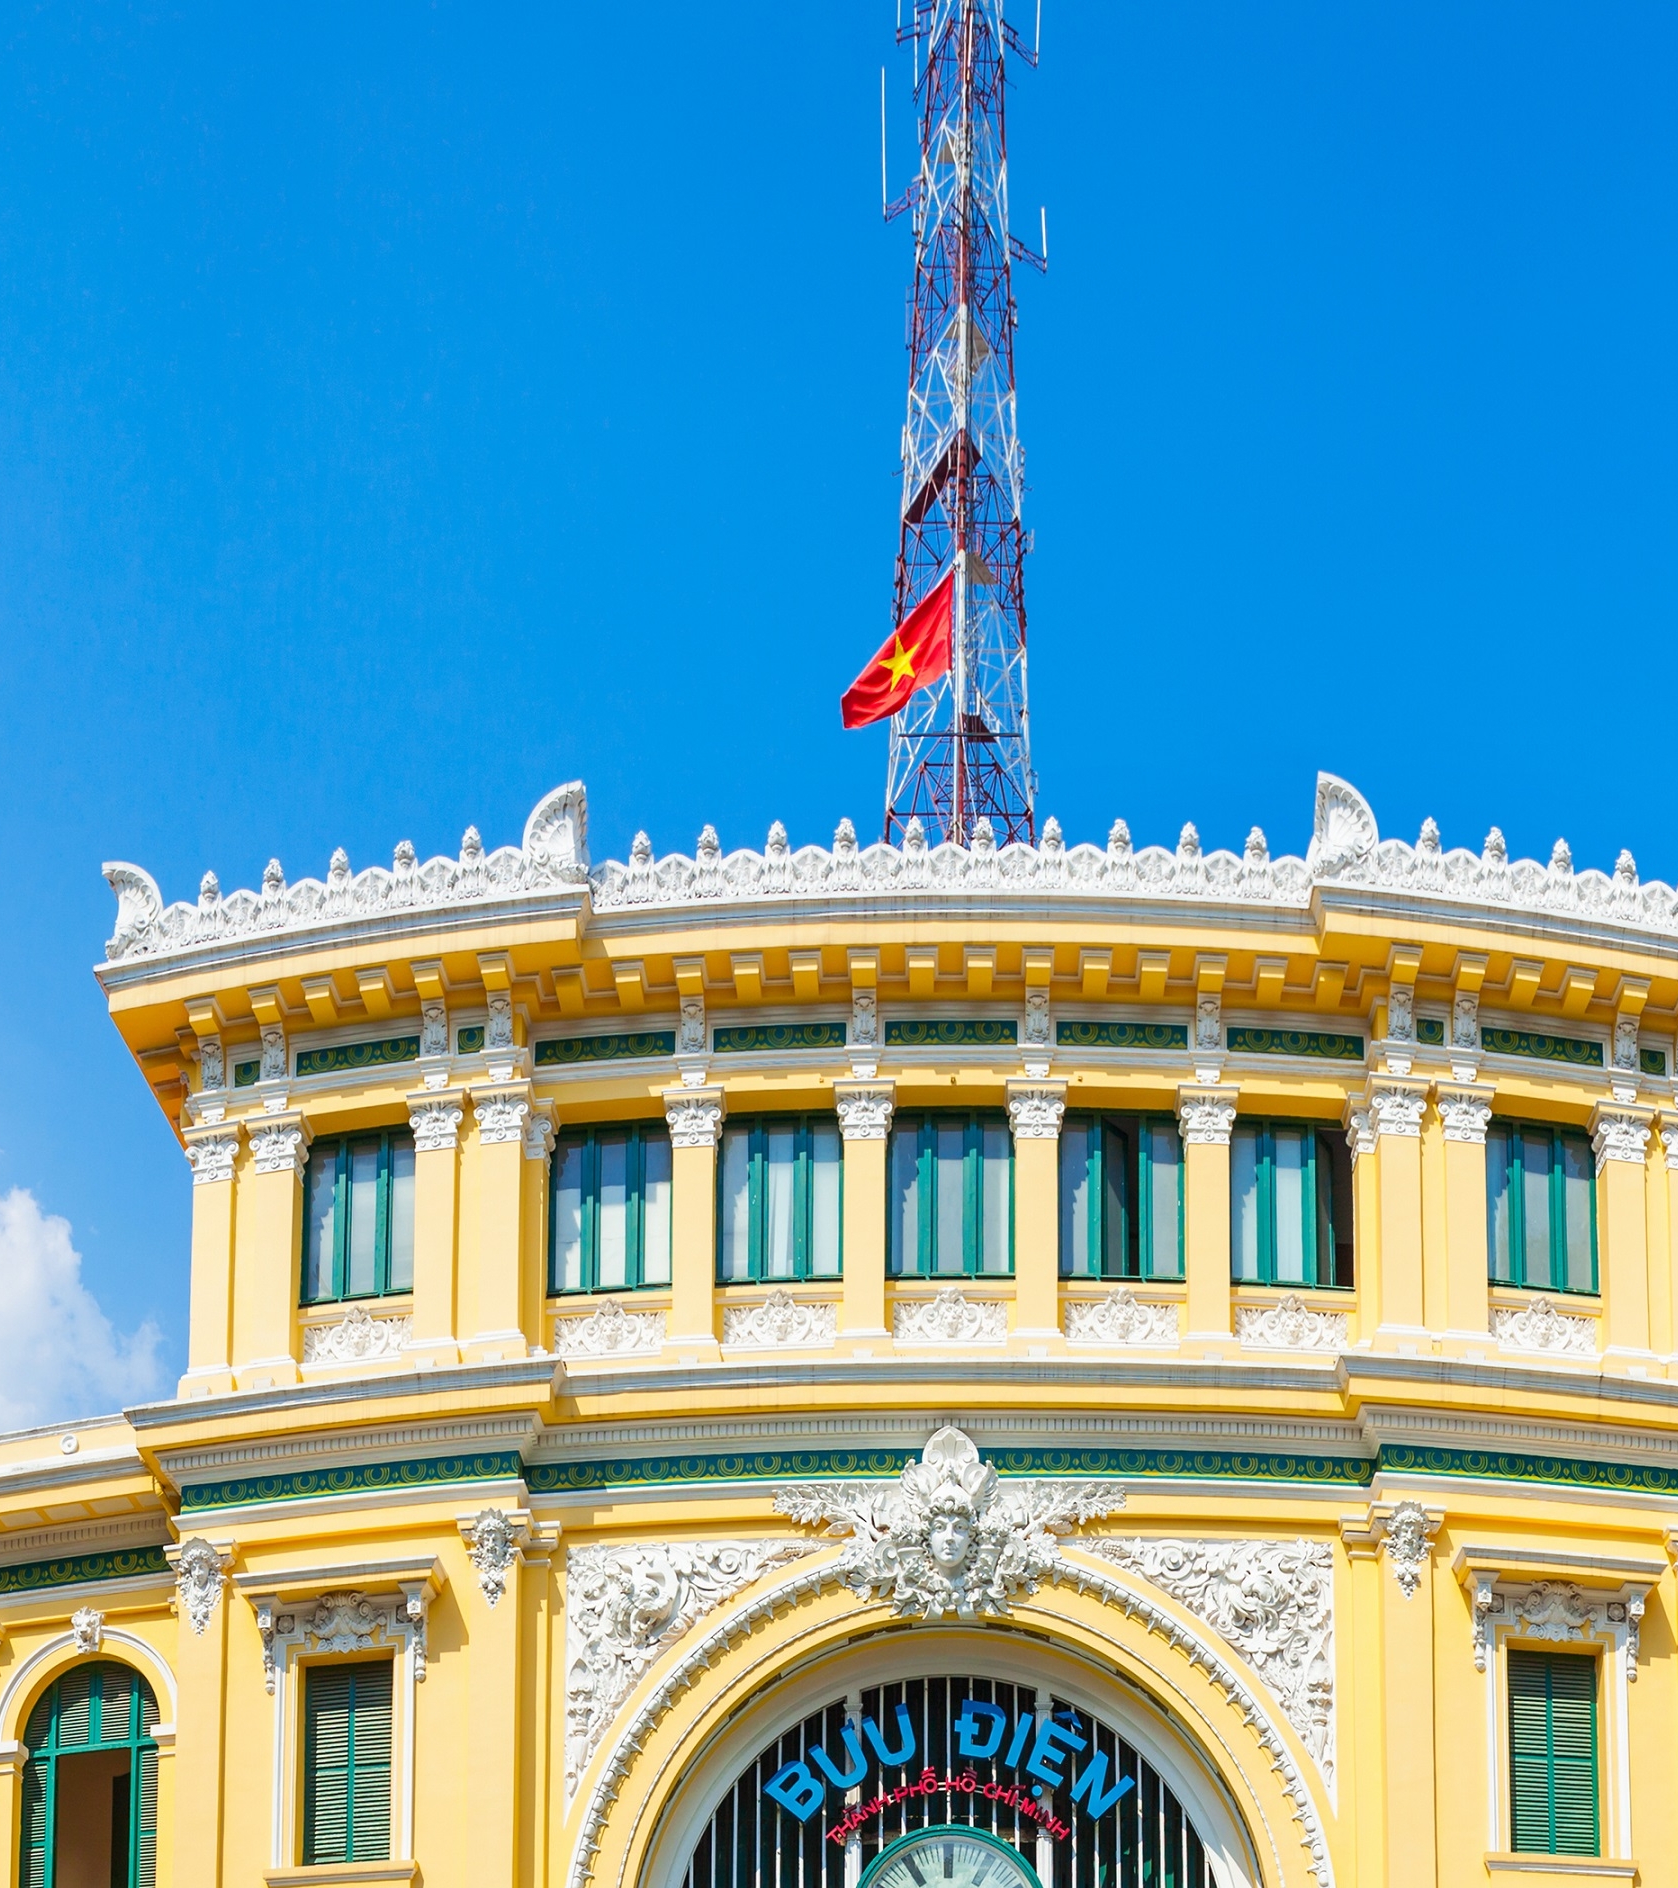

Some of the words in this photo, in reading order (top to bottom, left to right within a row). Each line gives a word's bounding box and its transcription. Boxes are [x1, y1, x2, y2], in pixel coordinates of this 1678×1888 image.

[763, 1703, 916, 1823] BƯU
[954, 1699, 1135, 1821] ĐIỆN
[825, 1791, 892, 1845] THÀNH
[893, 1765, 938, 1804] PHỐ
[945, 1765, 978, 1793] HỒ
[982, 1782, 1027, 1808] CHÍ
[1019, 1797, 1071, 1841] MINH
